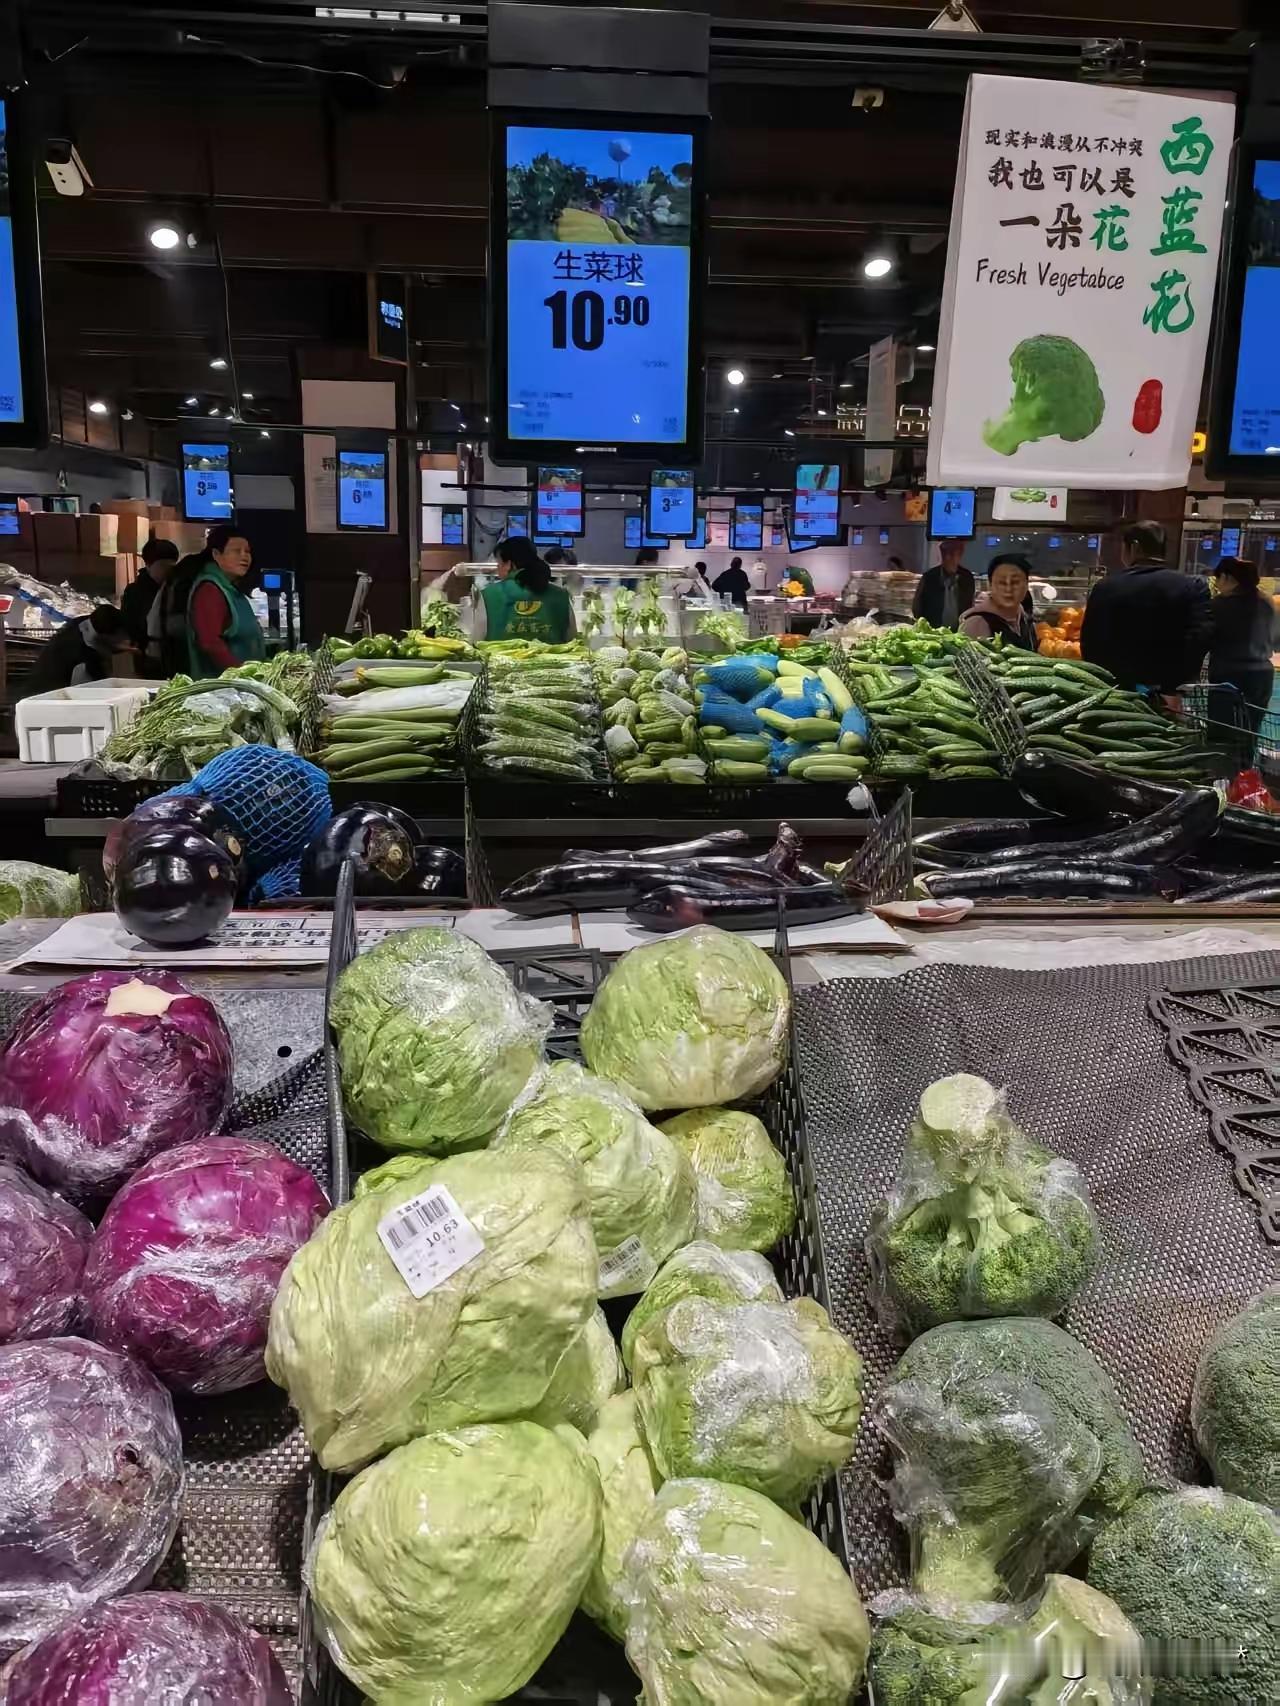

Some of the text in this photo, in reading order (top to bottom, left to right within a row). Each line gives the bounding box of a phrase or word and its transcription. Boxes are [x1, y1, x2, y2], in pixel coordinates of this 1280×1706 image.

[984, 128, 1144, 158] 现实和浪漫从不冲突
[987, 156, 1137, 198] 我也可以是
[999, 202, 1130, 252] 一朵花
[1143, 116, 1214, 334] 西蓝花
[553, 249, 644, 282] 生菜球
[976, 258, 1027, 286] Fresh
[543, 290, 650, 351] 10.90
